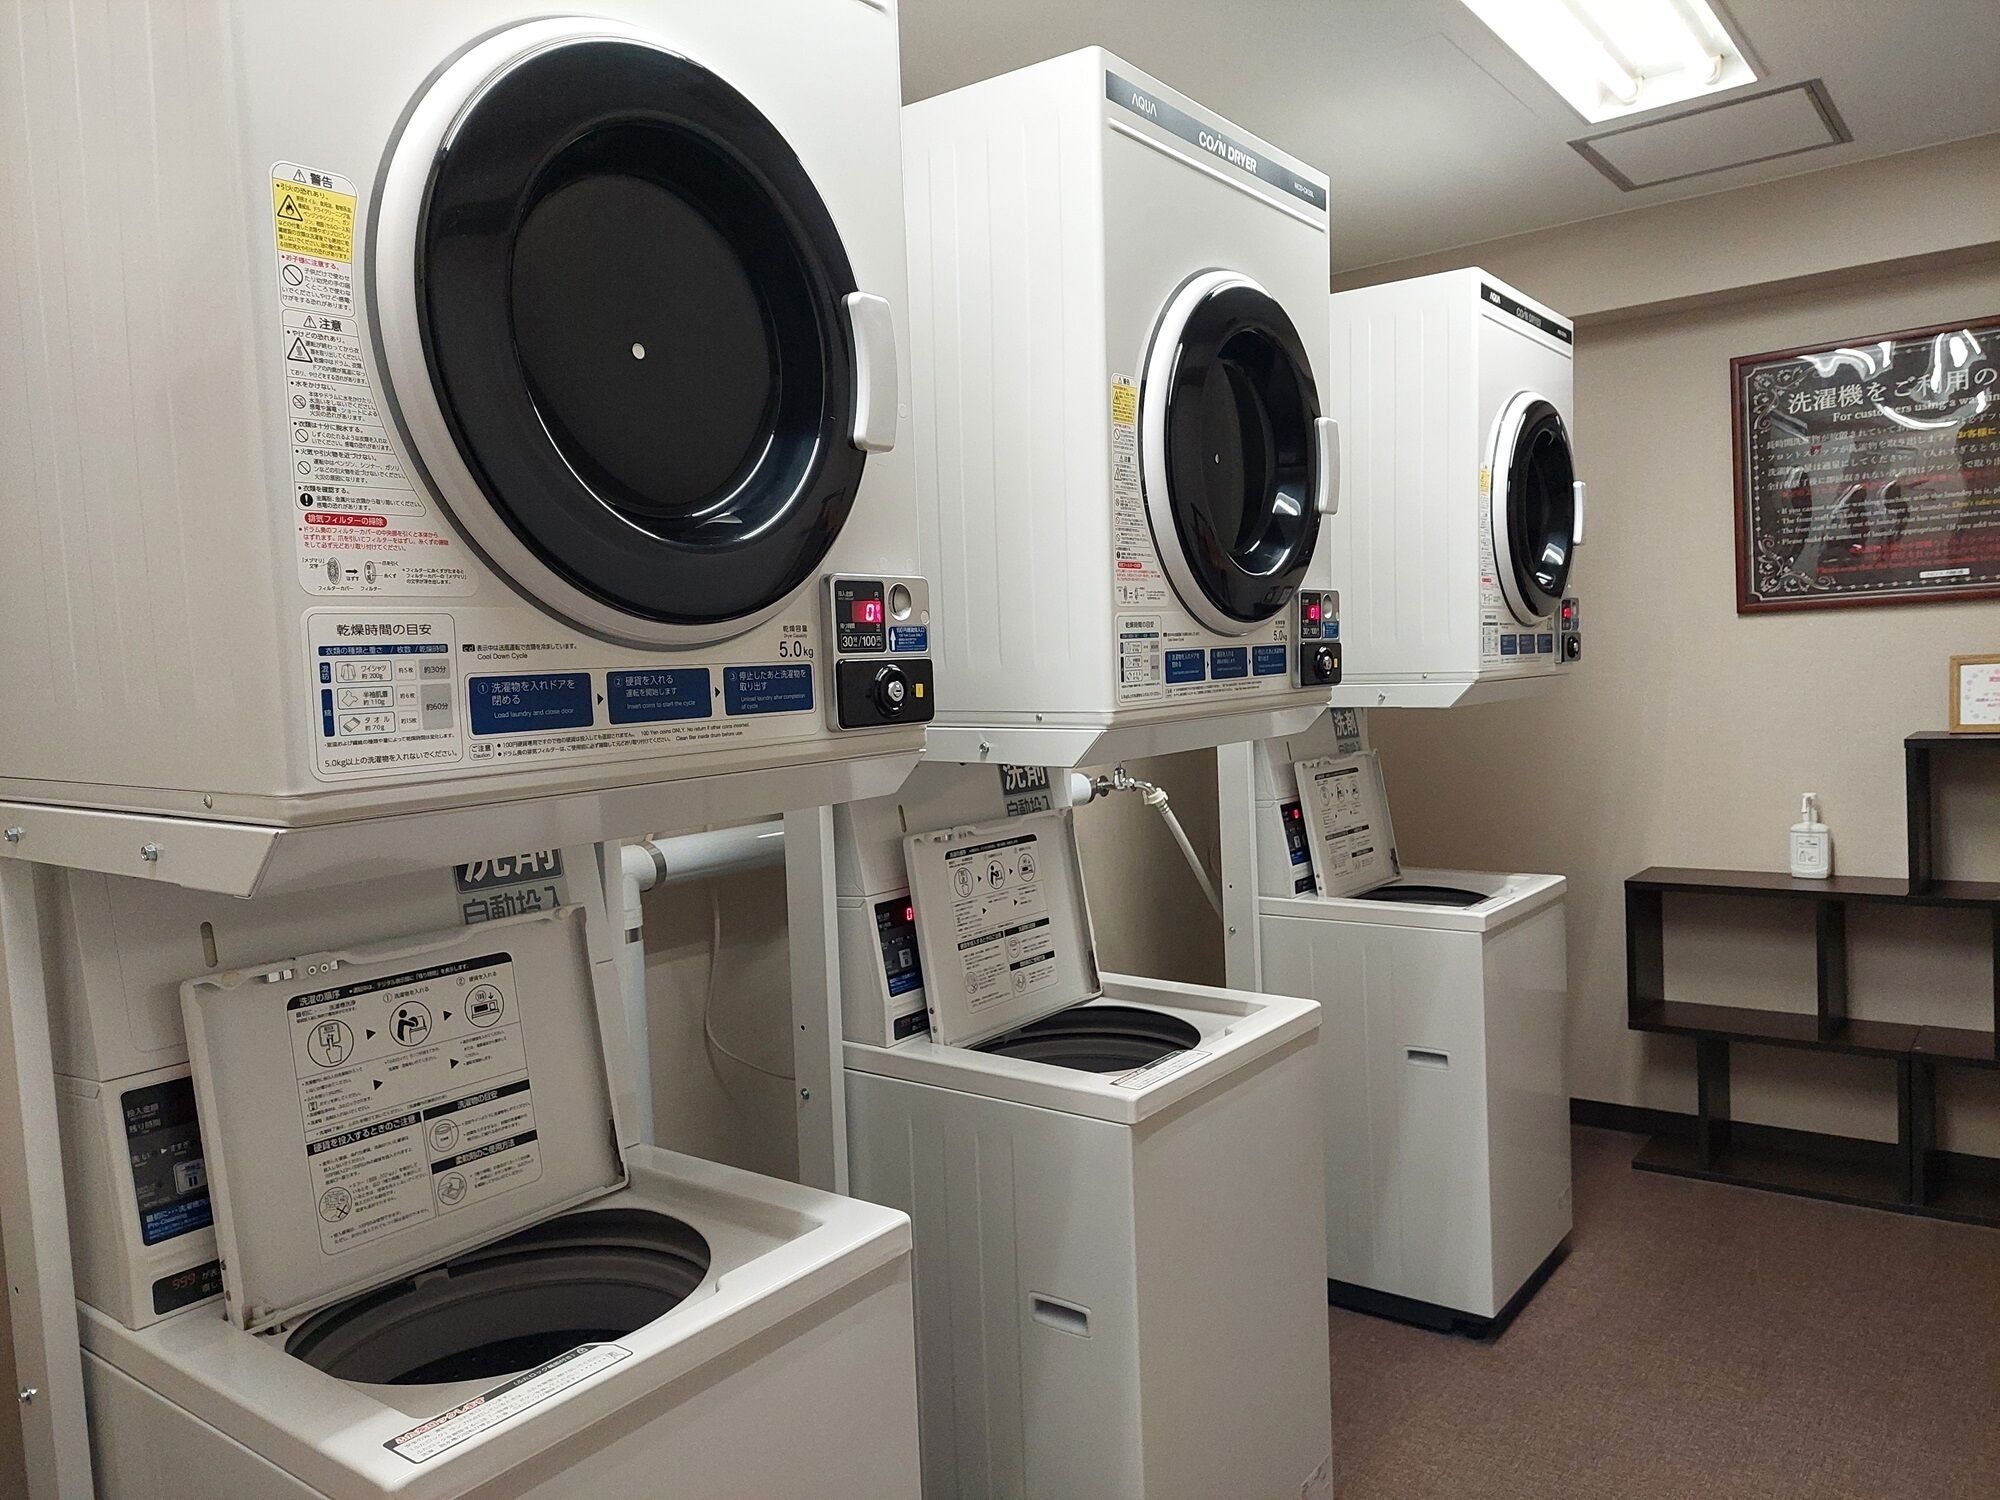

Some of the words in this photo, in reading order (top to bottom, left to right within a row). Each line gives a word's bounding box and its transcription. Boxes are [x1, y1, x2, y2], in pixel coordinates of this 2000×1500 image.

[1131, 93, 1158, 117] AQUA
[1199, 131, 1227, 157] COIN
[1228, 147, 1257, 173] DRYER
[310, 173, 333, 189] 警告
[280, 184, 328, 199] 引火の恐れあり。
[286, 255, 339, 270] お子様に注意する。
[304, 267, 350, 281] 子供だけで使わせ
[306, 283, 351, 296] くところで使わな
[283, 294, 351, 311] けがをする恐れがあります。
[319, 318, 343, 332] 注意
[292, 330, 345, 343] やけどの恐れあり。
[295, 380, 336, 391] 水をかけない。
[1833, 412, 1852, 422] For
[1914, 401, 1947, 411] using
[299, 421, 363, 433] 衣類は十分に脱水する。
[301, 449, 376, 461] 火気や引火物を近づけない。
[304, 485, 350, 494] 衣類を確認する。
[308, 513, 384, 526] 排気フィルターの掃除
[866, 603, 875, 621] 0
[1310, 607, 1314, 619] 0
[336, 624, 432, 637] 乾燥時間の目安
[783, 625, 808, 633] 乾燥容量
[325, 646, 383, 654] 衣類の種類と重さ
[419, 645, 446, 653] 乾燥時間
[424, 666, 446, 674] 約30分
[739, 669, 806, 681] 停止したあと洗濯物を
[491, 679, 575, 693] 洗濯物を入れドアを
[625, 674, 674, 687] 硬貨を入れる
[739, 682, 767, 691] 取り出す
[625, 687, 677, 698] 運転を開始します
[426, 703, 448, 711] 約60分
[491, 695, 521, 706] 閉める
[682, 700, 696, 708] cycle
[512, 710, 531, 718] laundry
[325, 750, 457, 768] 5.0kg以上の洗濯物を入れないでください。
[298, 989, 341, 1007] 洗濯の順序
[394, 986, 430, 999] 洗濯物を入れる
[457, 1091, 498, 1110] 洗濯物の目安
[313, 1115, 417, 1153] 硬貨を投入するときのご注意
[455, 1139, 515, 1165] 柔軟剤のご使用方法
